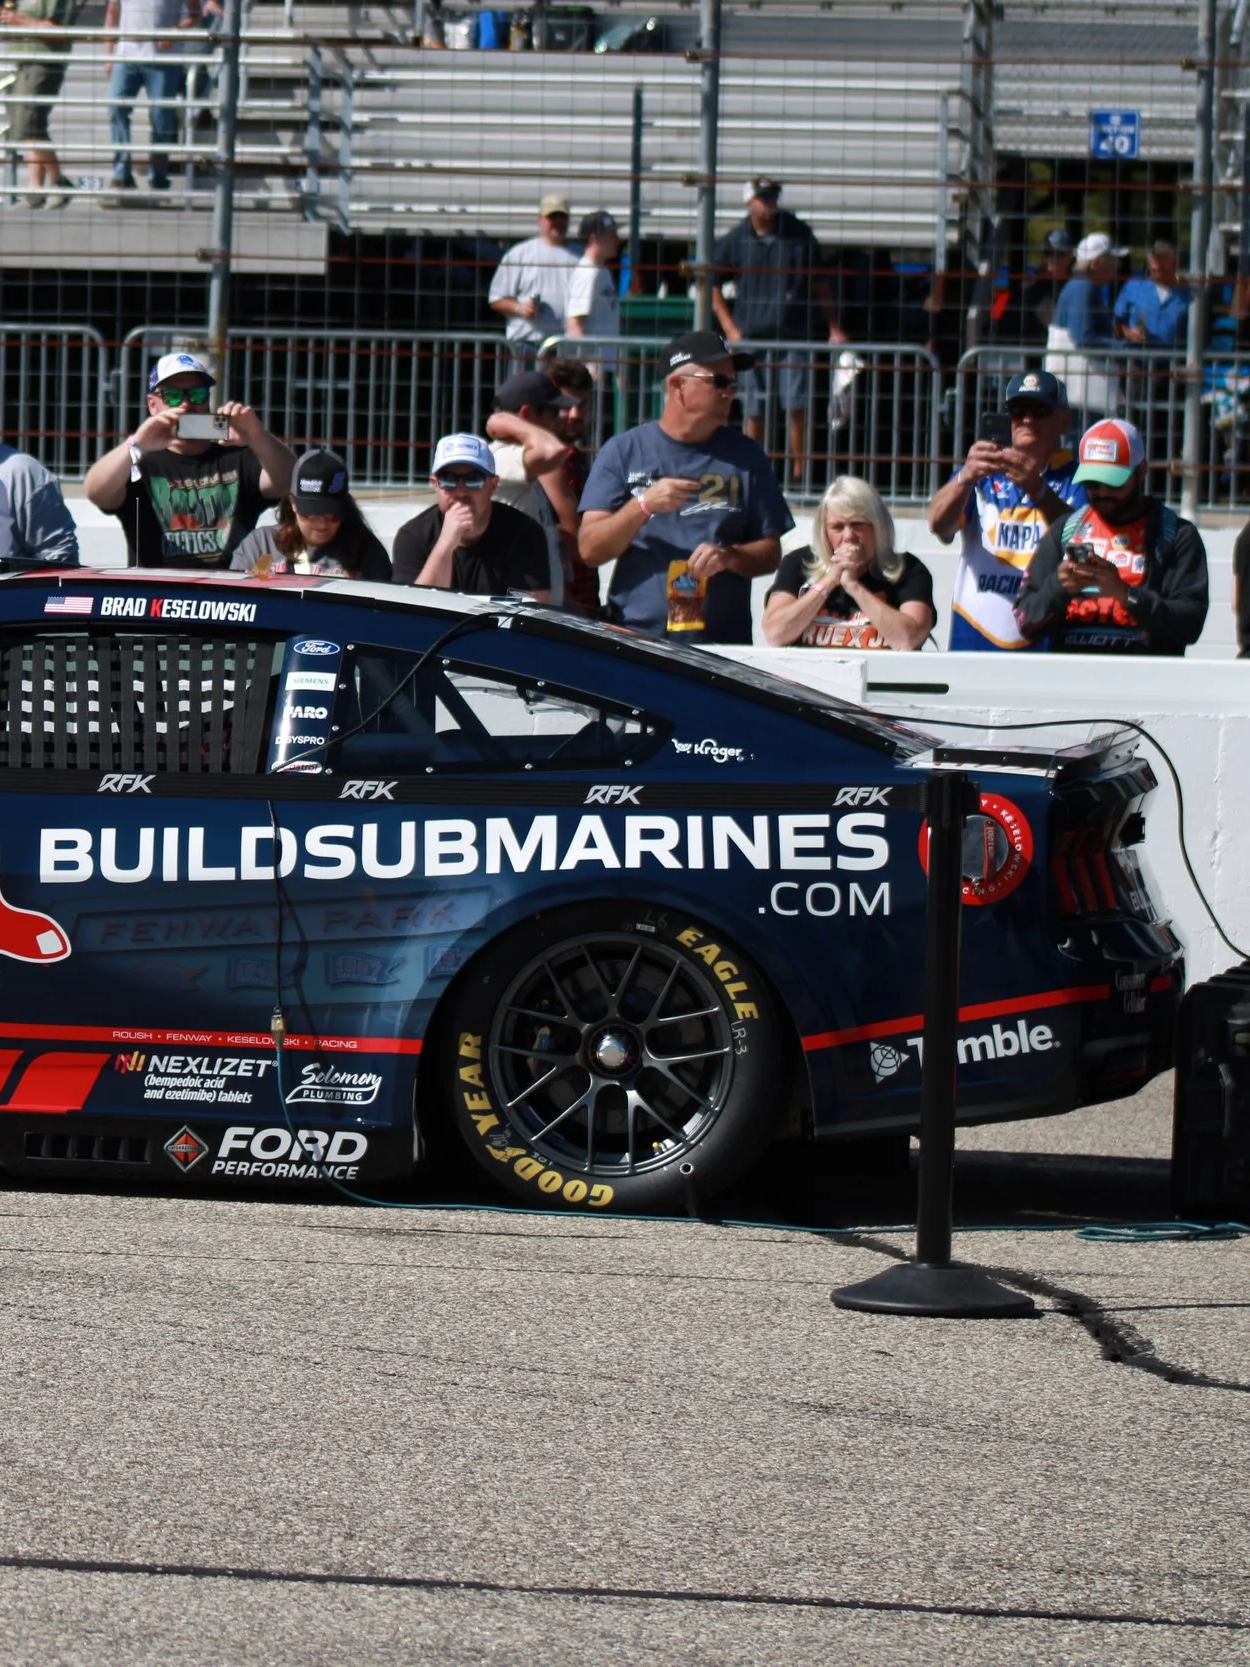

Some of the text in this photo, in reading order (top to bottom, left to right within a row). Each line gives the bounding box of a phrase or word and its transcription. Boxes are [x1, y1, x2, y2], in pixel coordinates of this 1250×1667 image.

[697, 473, 740, 508] 21
[997, 521, 1041, 550] NAPA
[978, 574, 1024, 594] RACIN
[100, 596, 257, 623] BRAD KESELOWSKI
[301, 640, 332, 654] Ford
[800, 625, 867, 649] RUEX
[293, 677, 330, 685] SIEMENS
[694, 738, 742, 763] Kroger
[97, 773, 157, 794] RFK
[338, 780, 399, 801] RFK
[583, 785, 645, 805] RFK
[832, 786, 893, 807] RFK
[39, 812, 890, 884] BUILDSUBMARINES
[758, 881, 890, 917] .COM
[100, 901, 456, 944] FENWAY PARK
[675, 926, 759, 1020] EAGLE
[112, 1031, 153, 1040] ROUSH
[166, 1033, 213, 1042] FENWAY
[313, 1039, 358, 1049] RACING
[144, 1074, 226, 1089] (bempedoic acid
[144, 1088, 253, 1104] and ezetimibe) tablets
[302, 1089, 363, 1101] PLUMBING
[217, 1126, 369, 1163] FORD
